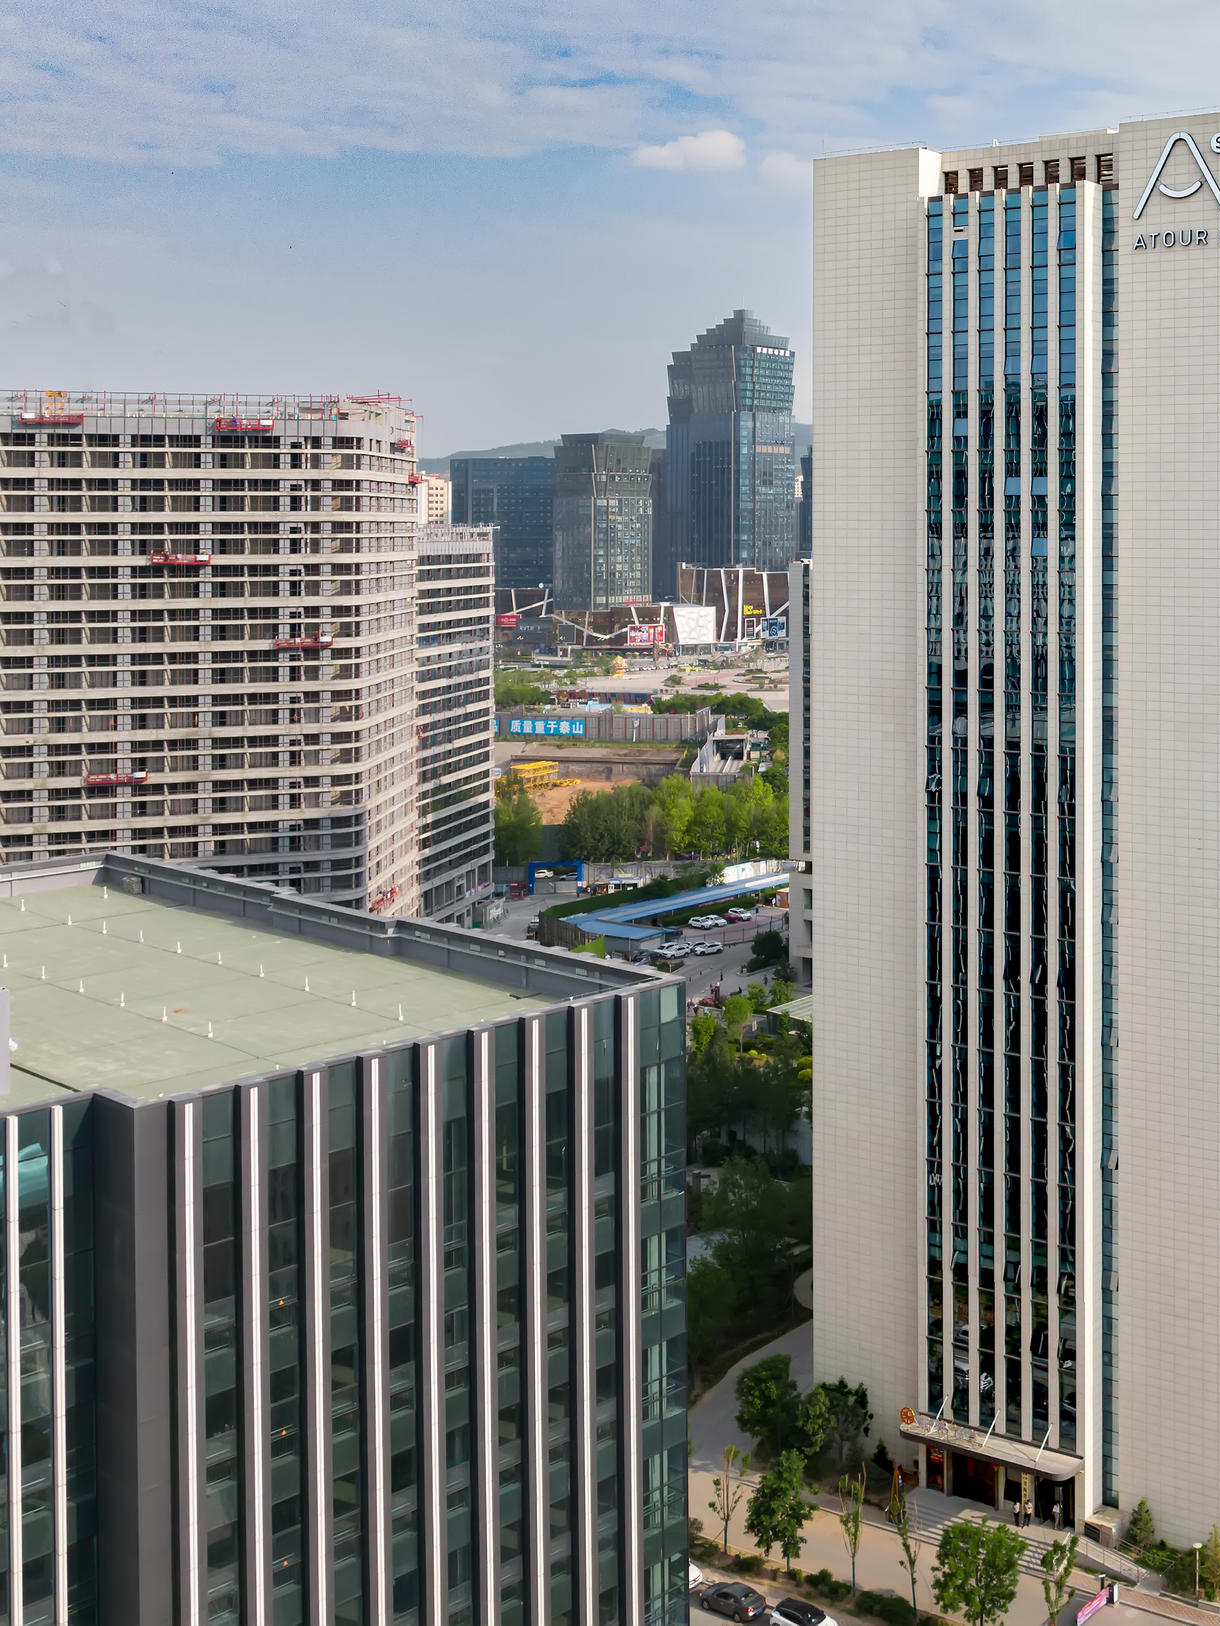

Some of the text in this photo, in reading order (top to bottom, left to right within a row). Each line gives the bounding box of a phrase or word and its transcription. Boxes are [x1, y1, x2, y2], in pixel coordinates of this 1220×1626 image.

[1133, 228, 1209, 250] ATOUR
[510, 719, 584, 734] 质量重于泰山
